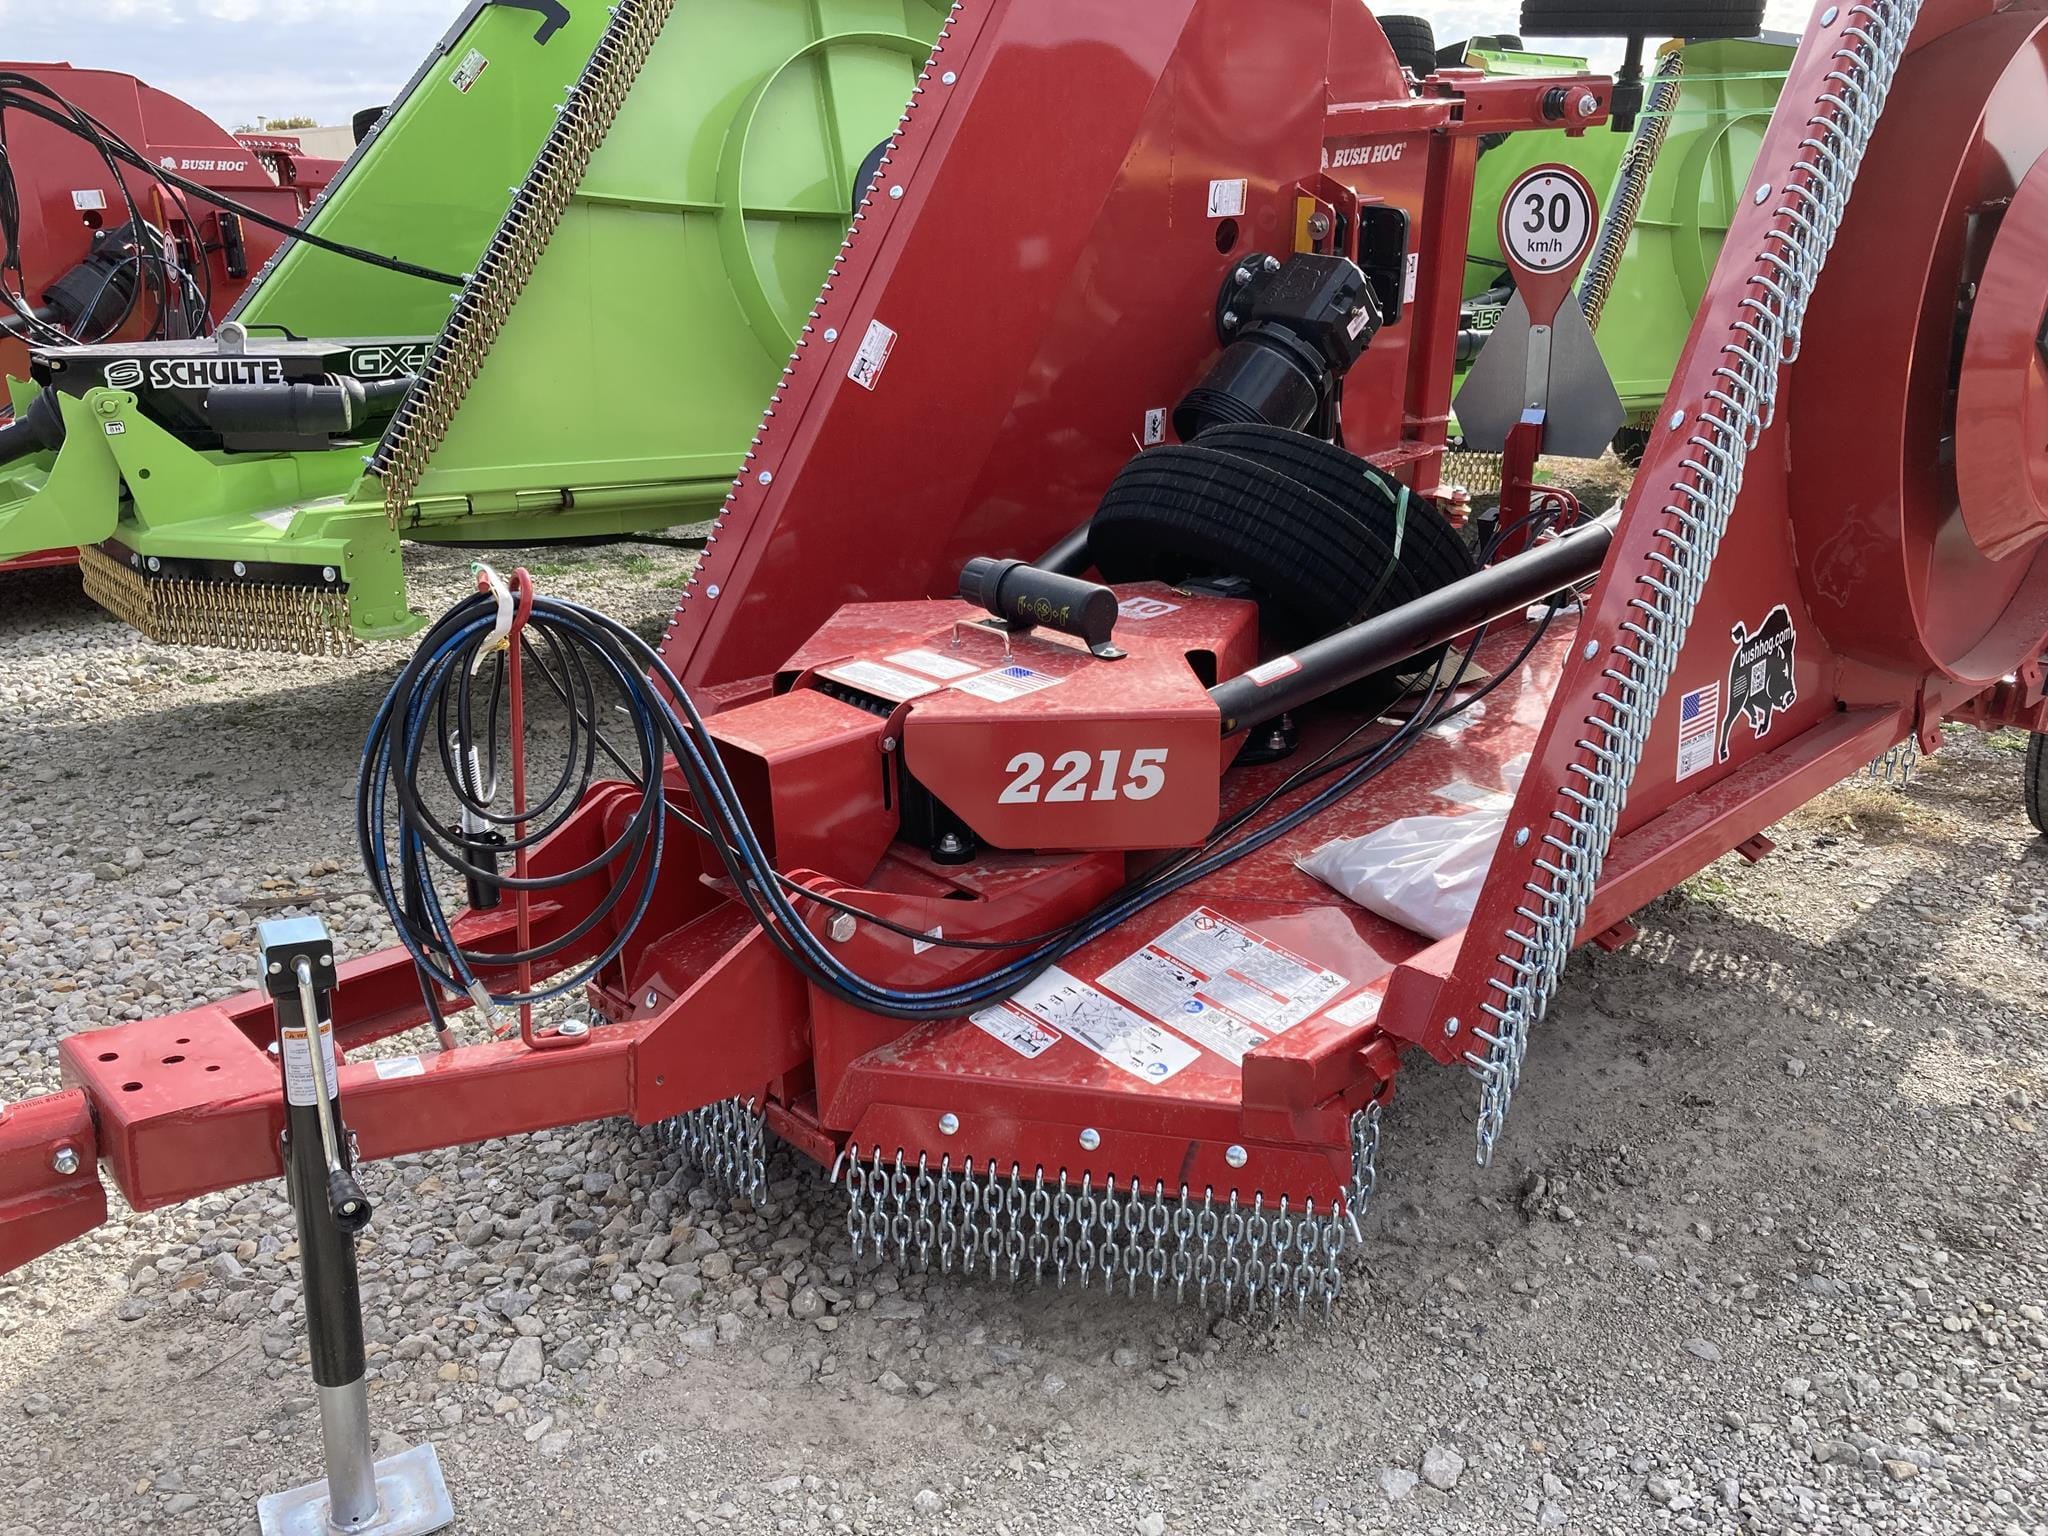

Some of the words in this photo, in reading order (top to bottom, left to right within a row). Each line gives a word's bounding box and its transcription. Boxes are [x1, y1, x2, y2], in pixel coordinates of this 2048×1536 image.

[181, 160, 215, 170] BUSH
[1332, 147, 1371, 168] BUSH
[1523, 193, 1571, 233] 30
[1527, 238, 1562, 252] km/h
[150, 358, 284, 389] SCHULTE
[350, 345, 432, 377] GX-
[1739, 626, 1791, 667] bushhog.com
[998, 748, 1168, 804] 2215
